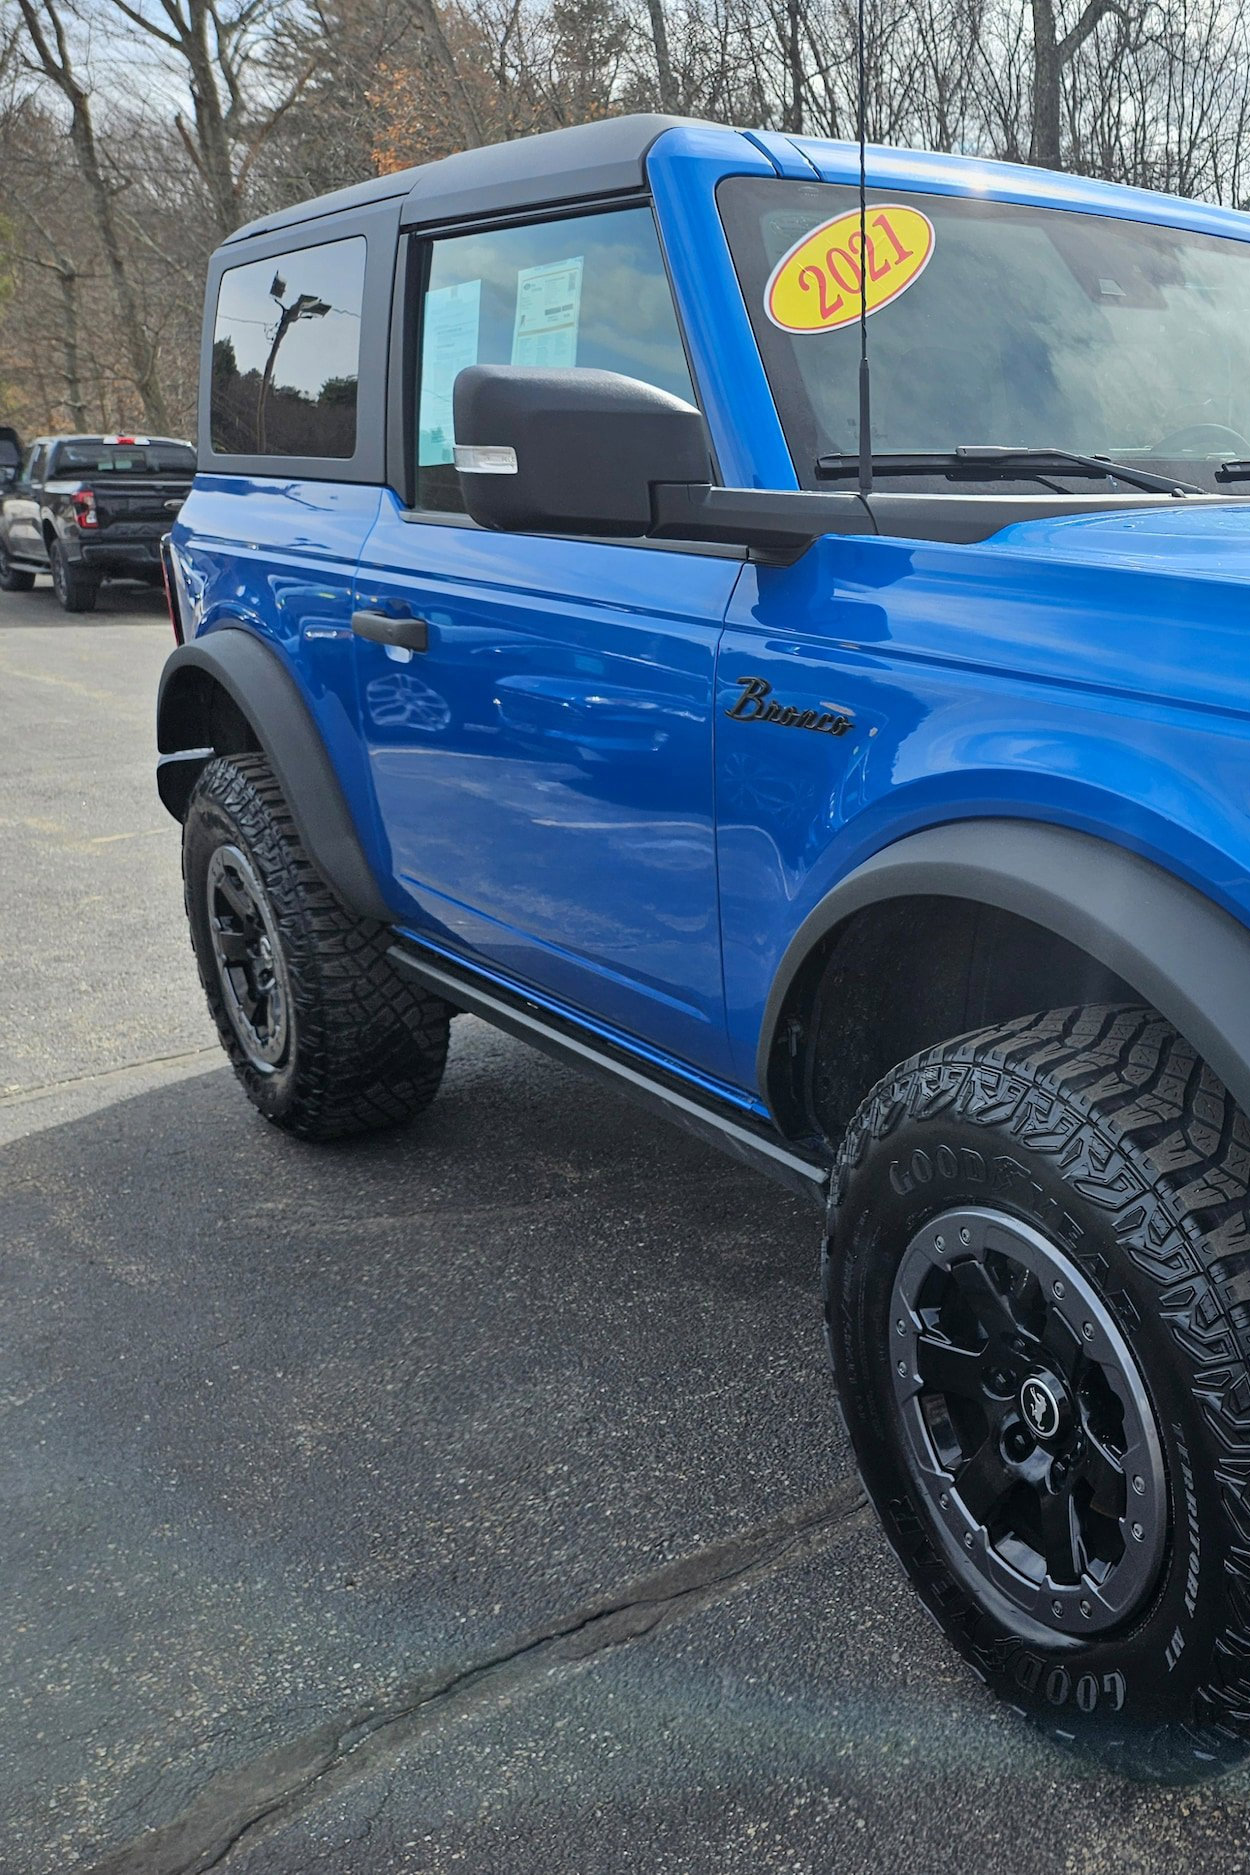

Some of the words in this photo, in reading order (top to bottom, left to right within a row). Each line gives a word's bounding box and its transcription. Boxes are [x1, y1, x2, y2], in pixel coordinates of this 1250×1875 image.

[798, 214, 914, 320] 2021
[724, 676, 856, 736] Bronco
[889, 1144, 1142, 1333] GOODYEAR
[1172, 1422, 1201, 1619] TERRITORY
